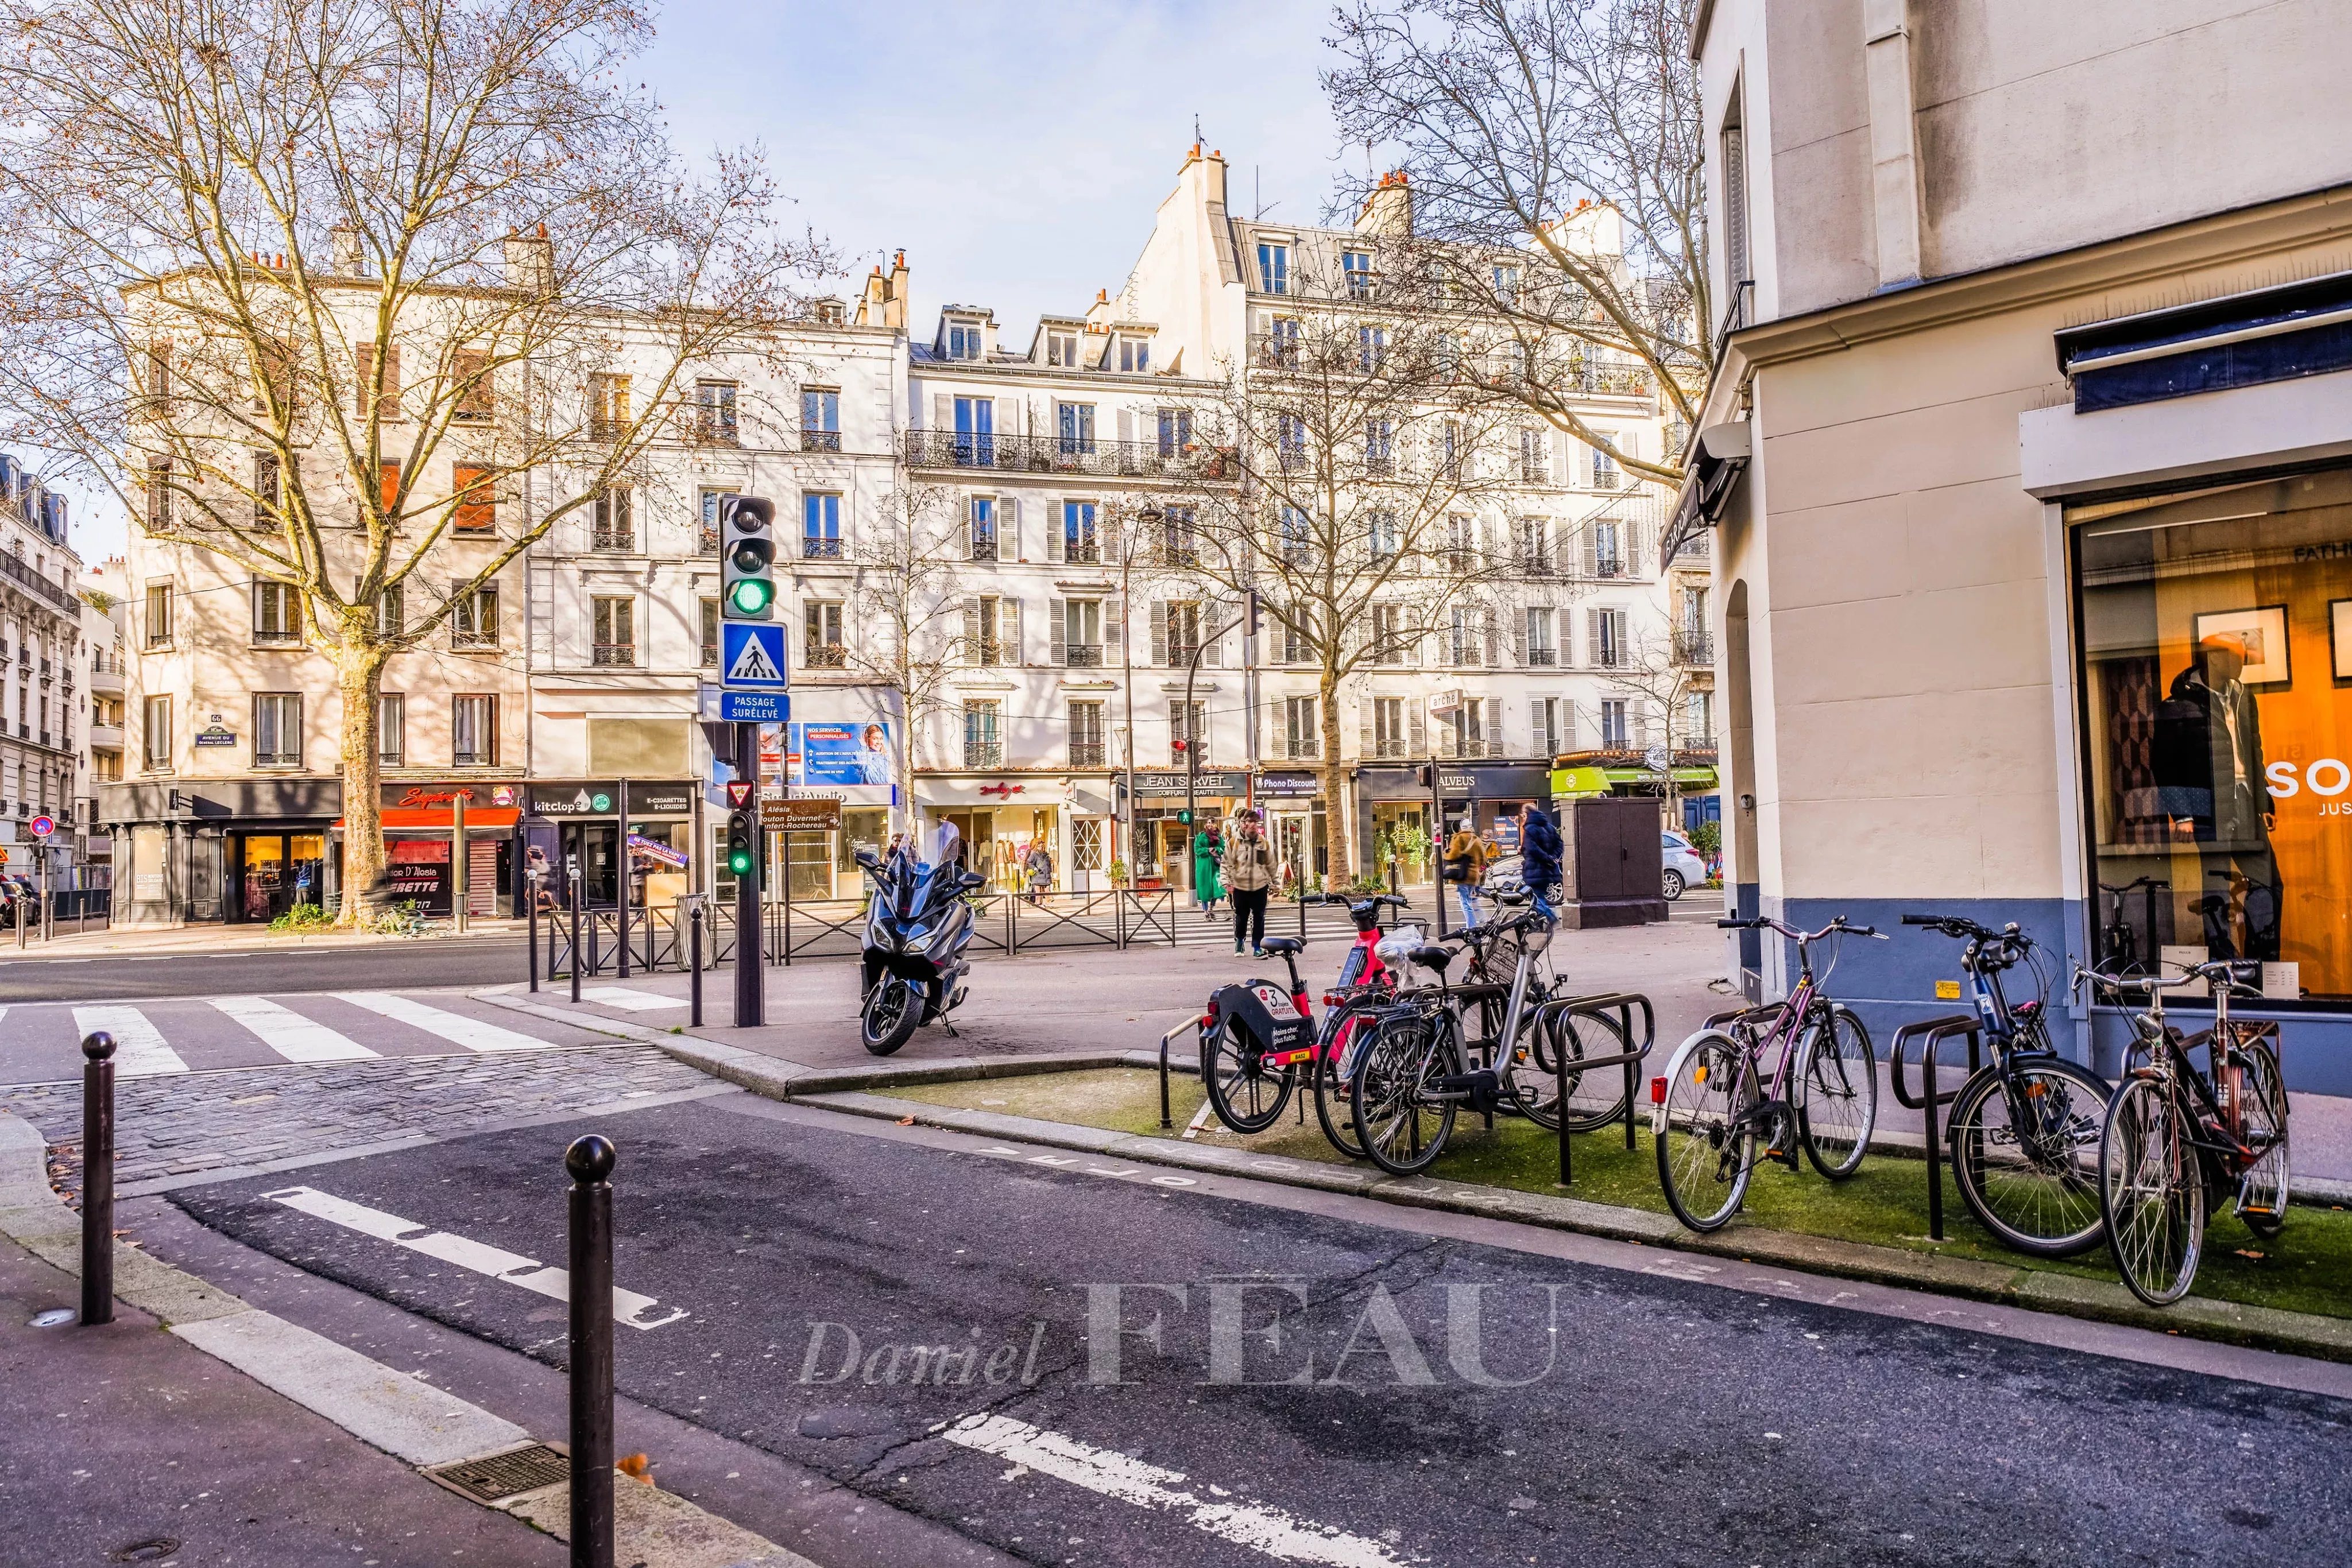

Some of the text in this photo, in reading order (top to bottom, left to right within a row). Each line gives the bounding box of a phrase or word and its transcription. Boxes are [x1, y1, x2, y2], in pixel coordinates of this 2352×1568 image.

[2293, 542, 2352, 561] FATH
[734, 696, 775, 707] PASSAGE
[1433, 694, 1455, 707] arche
[732, 707, 779, 718] SURÉLEVÉ
[1143, 776, 1174, 787] JEAN
[1264, 779, 1317, 787] Phone Discount
[1438, 776, 1475, 786] ALVEUS
[2266, 758, 2351, 798] SO
[399, 788, 475, 810] Supérete
[2318, 802, 2352, 816] JUS
[641, 839, 653, 847] TUEZ
[668, 850, 680, 859] VAPE
[136, 874, 148, 883] BIS
[390, 882, 439, 893] ERETTE
[416, 901, 431, 909] 7/7
[1268, 989, 1278, 1008] 3
[1271, 1007, 1295, 1016] GRATUITS
[1272, 1028, 1287, 1037] Moins
[1273, 1037, 1283, 1046] plus
[977, 1146, 1197, 1186] VELO
